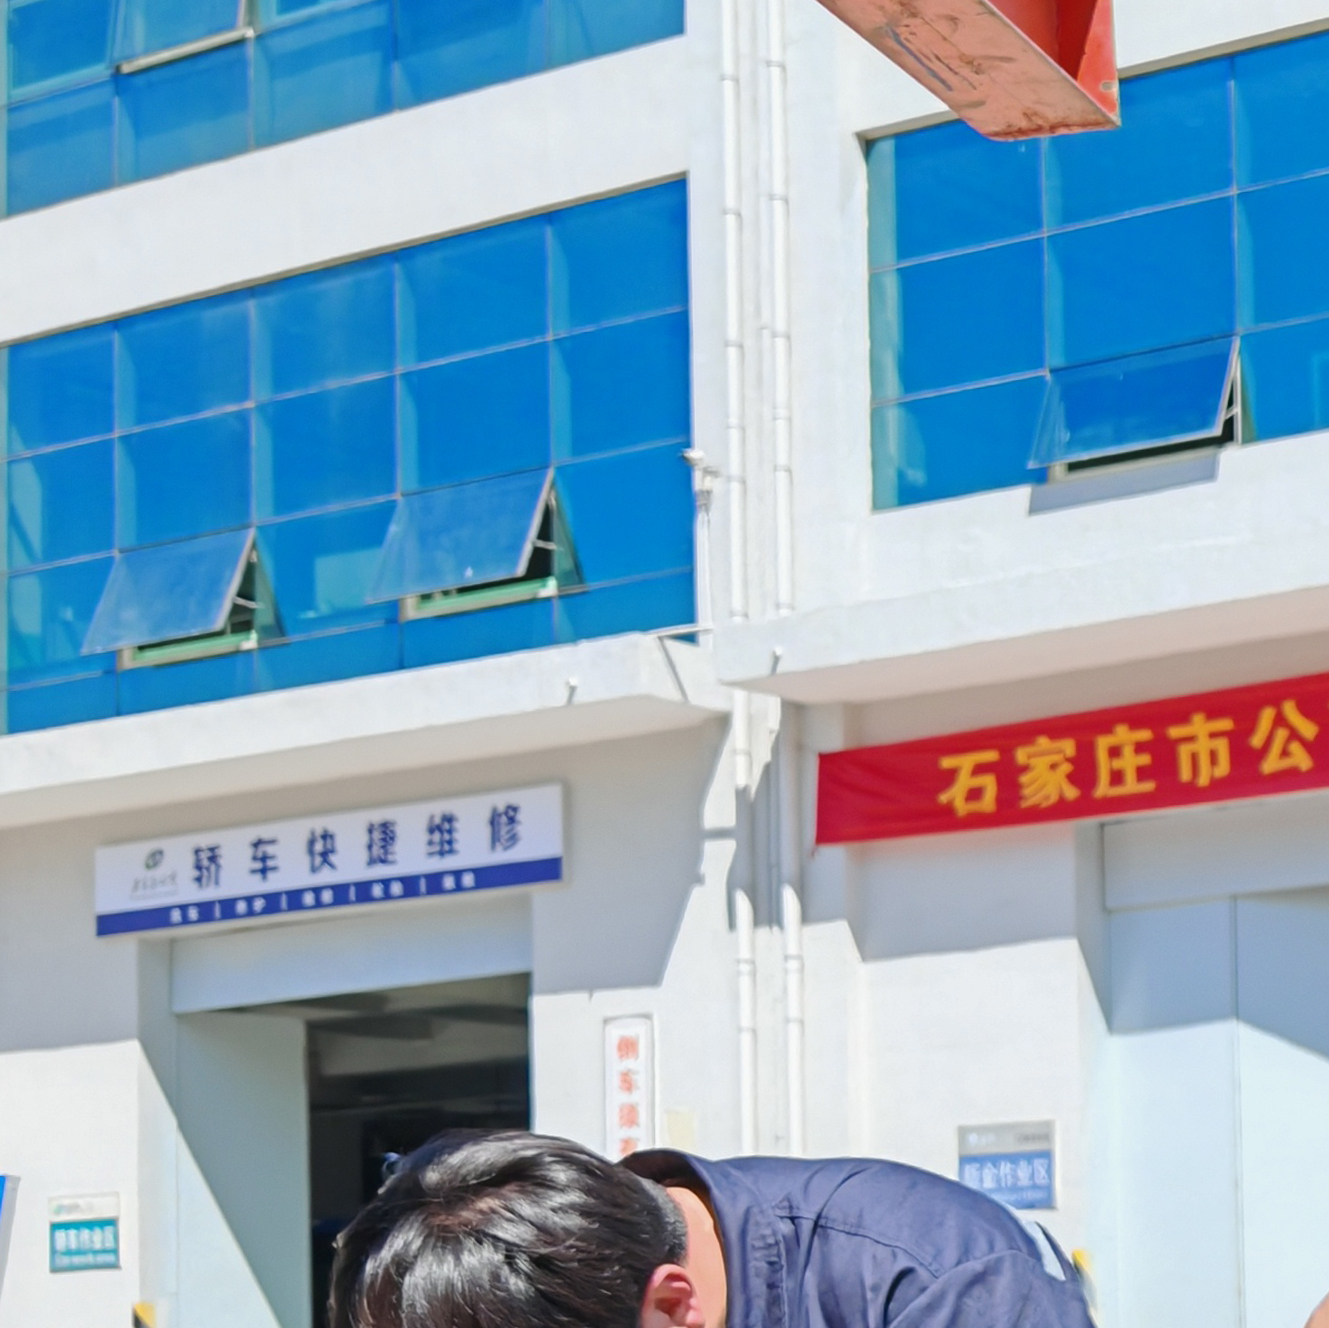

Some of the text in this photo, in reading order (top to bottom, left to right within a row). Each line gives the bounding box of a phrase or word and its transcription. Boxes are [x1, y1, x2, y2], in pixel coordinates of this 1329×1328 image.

[191, 803, 521, 890] 轿车快捷维修
